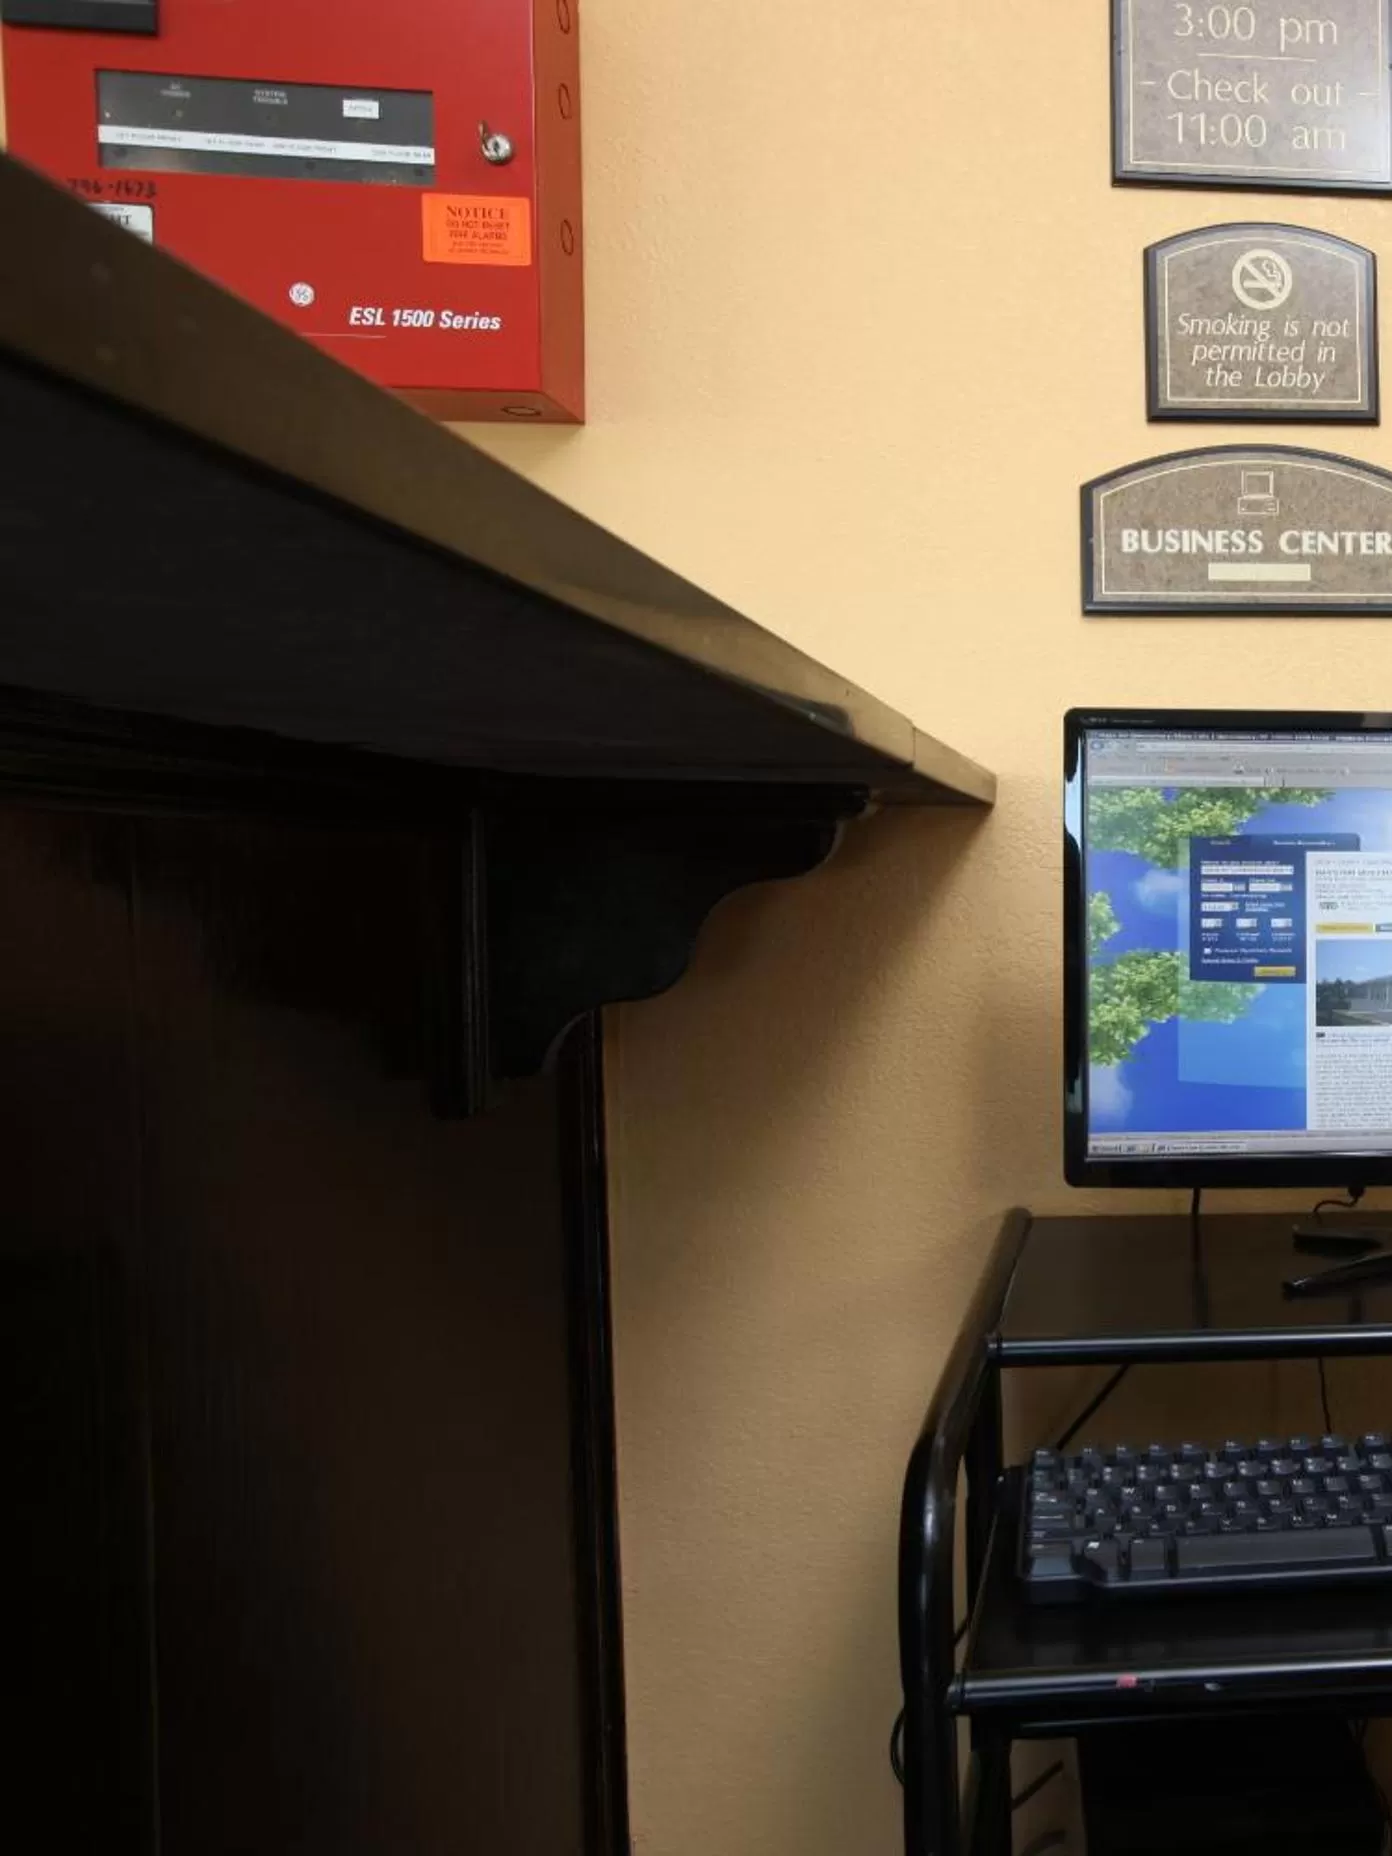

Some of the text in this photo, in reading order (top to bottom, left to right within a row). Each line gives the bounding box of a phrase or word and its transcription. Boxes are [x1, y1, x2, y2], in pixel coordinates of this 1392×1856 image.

[1173, 3, 1338, 52] 3:00 pm
[1167, 67, 1345, 106] Check out
[1166, 111, 1347, 151] 11:00 am
[445, 204, 510, 219] NOTICE
[350, 306, 502, 330] ESL 1500 Series
[1177, 312, 1351, 342] Smoking is not
[1191, 340, 1337, 366] permitted in
[1206, 366, 1326, 394] the Lobby
[1120, 528, 1264, 554] BUSINESS
